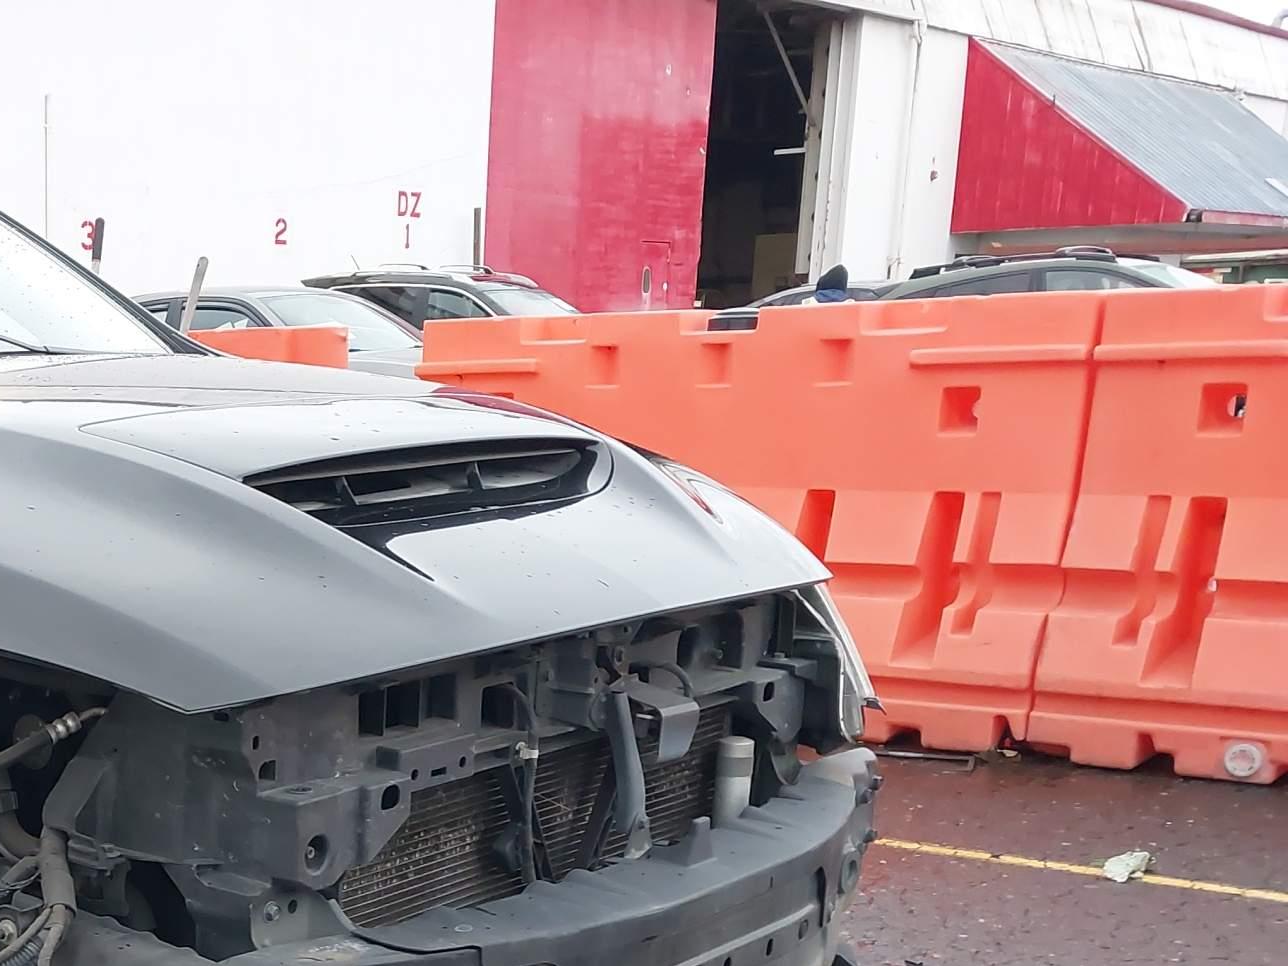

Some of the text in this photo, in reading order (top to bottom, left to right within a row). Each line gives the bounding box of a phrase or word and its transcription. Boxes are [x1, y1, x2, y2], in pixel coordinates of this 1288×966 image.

[397, 190, 422, 218] DZ
[81, 220, 96, 251] 3
[275, 217, 287, 245] 2
[404, 223, 410, 249] 1
